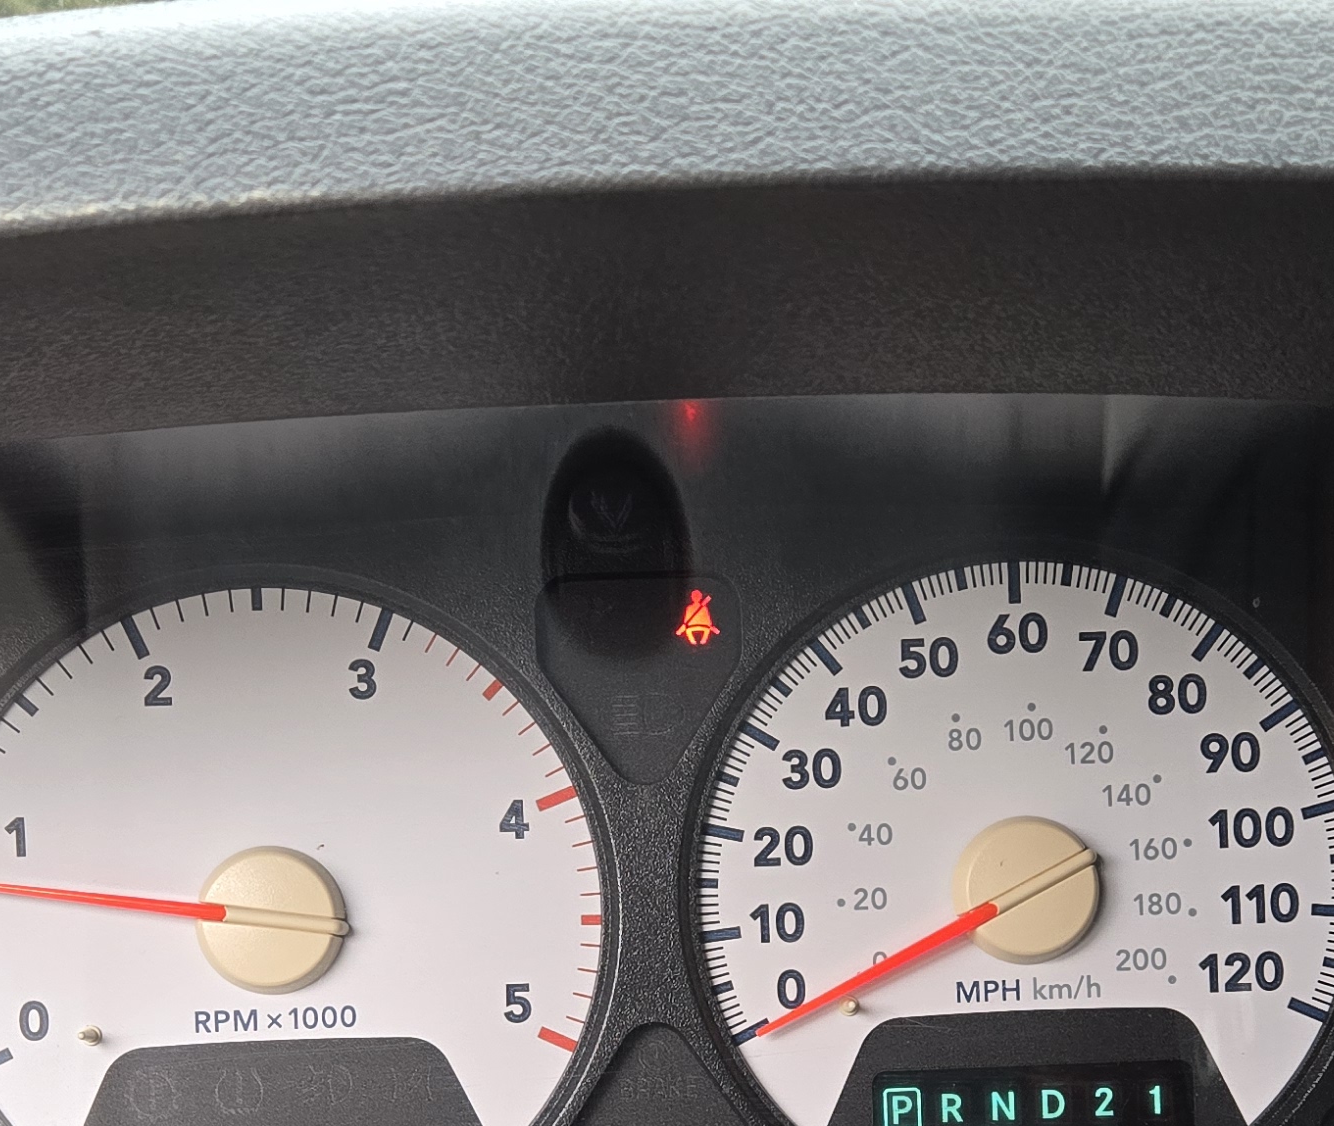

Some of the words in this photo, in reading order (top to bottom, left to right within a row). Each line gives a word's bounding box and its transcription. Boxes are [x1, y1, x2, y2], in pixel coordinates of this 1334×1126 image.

[986, 612, 1048, 655] 60
[1078, 629, 1139, 672] 70
[898, 636, 959, 679] 50
[143, 665, 173, 707] 2
[347, 658, 377, 700] 3
[1147, 673, 1207, 716] 80
[824, 685, 888, 728] 40
[948, 727, 982, 752] 80
[1003, 717, 1054, 742] 100
[781, 747, 842, 791] 30
[1064, 740, 1114, 765] 120
[1199, 731, 1261, 774] 90
[892, 767, 927, 791] 60
[1102, 783, 1151, 808] 140
[4, 816, 27, 858] 1
[499, 799, 530, 840] 4
[858, 822, 893, 847] 40
[1207, 806, 1295, 849] 100
[753, 825, 814, 868] 20
[1129, 836, 1178, 861] 160
[853, 886, 888, 911] 20
[1133, 892, 1182, 916] 180
[1220, 882, 1300, 925] 110
[749, 902, 805, 944] 10
[1115, 947, 1167, 972] 200
[1198, 950, 1284, 994] 120
[503, 982, 532, 1024] 5
[776, 968, 806, 1010] 0
[956, 978, 1021, 1004] MPH
[1032, 974, 1101, 1001] km/h
[18, 1000, 50, 1042] 0
[194, 1008, 258, 1034] RPM
[891, 1094, 914, 1126] P
[941, 1093, 964, 1123] R
[991, 1090, 1016, 1121] N
[1041, 1089, 1066, 1119] D
[1094, 1087, 1114, 1117] 2
[1148, 1085, 1162, 1115] 1
